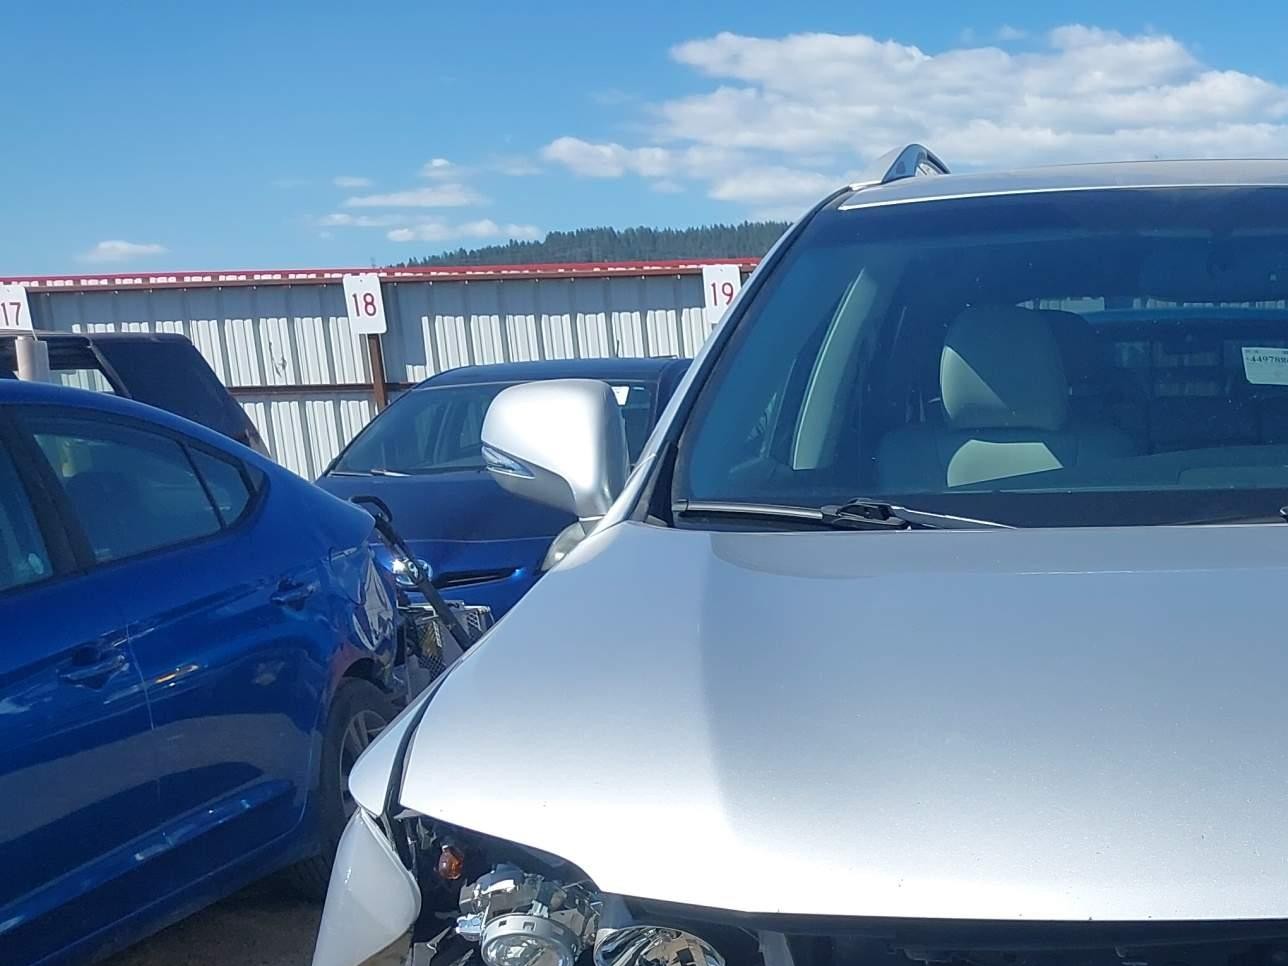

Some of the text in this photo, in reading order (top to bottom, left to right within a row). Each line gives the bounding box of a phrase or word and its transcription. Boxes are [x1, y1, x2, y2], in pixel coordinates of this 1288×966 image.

[352, 292, 377, 317] 18
[711, 282, 734, 306] 19
[0, 302, 21, 326] 17
